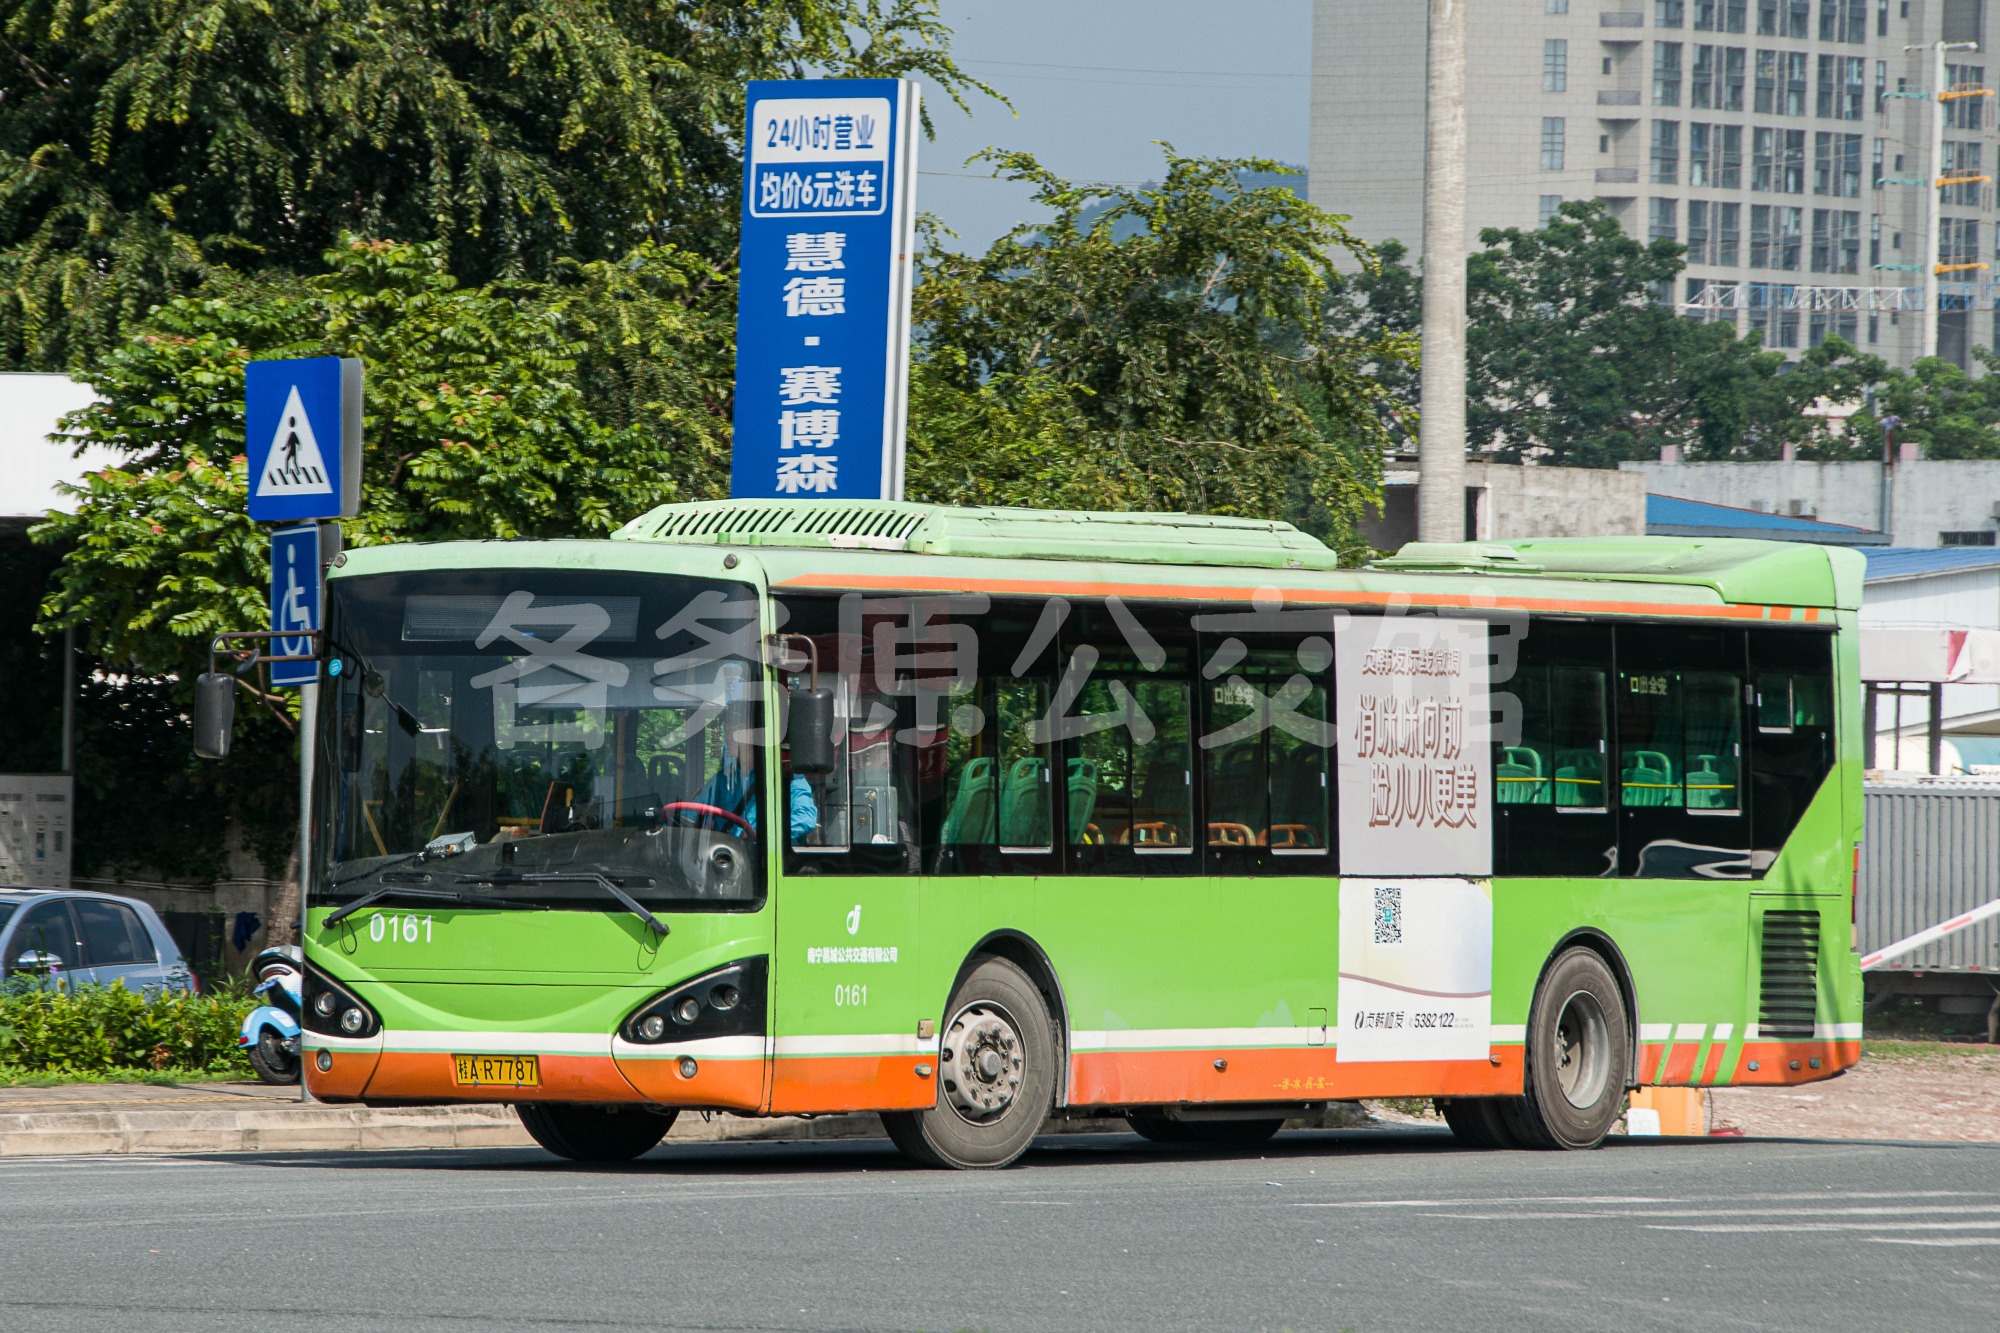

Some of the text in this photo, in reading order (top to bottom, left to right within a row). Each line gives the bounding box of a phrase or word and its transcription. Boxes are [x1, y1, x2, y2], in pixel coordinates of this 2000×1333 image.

[767, 114, 875, 151] 24小时营业
[760, 169, 878, 210] 均价6元洗车
[1368, 762, 1477, 829] 脸小小更美
[370, 912, 432, 943] 0161
[835, 983, 867, 1006] 0161
